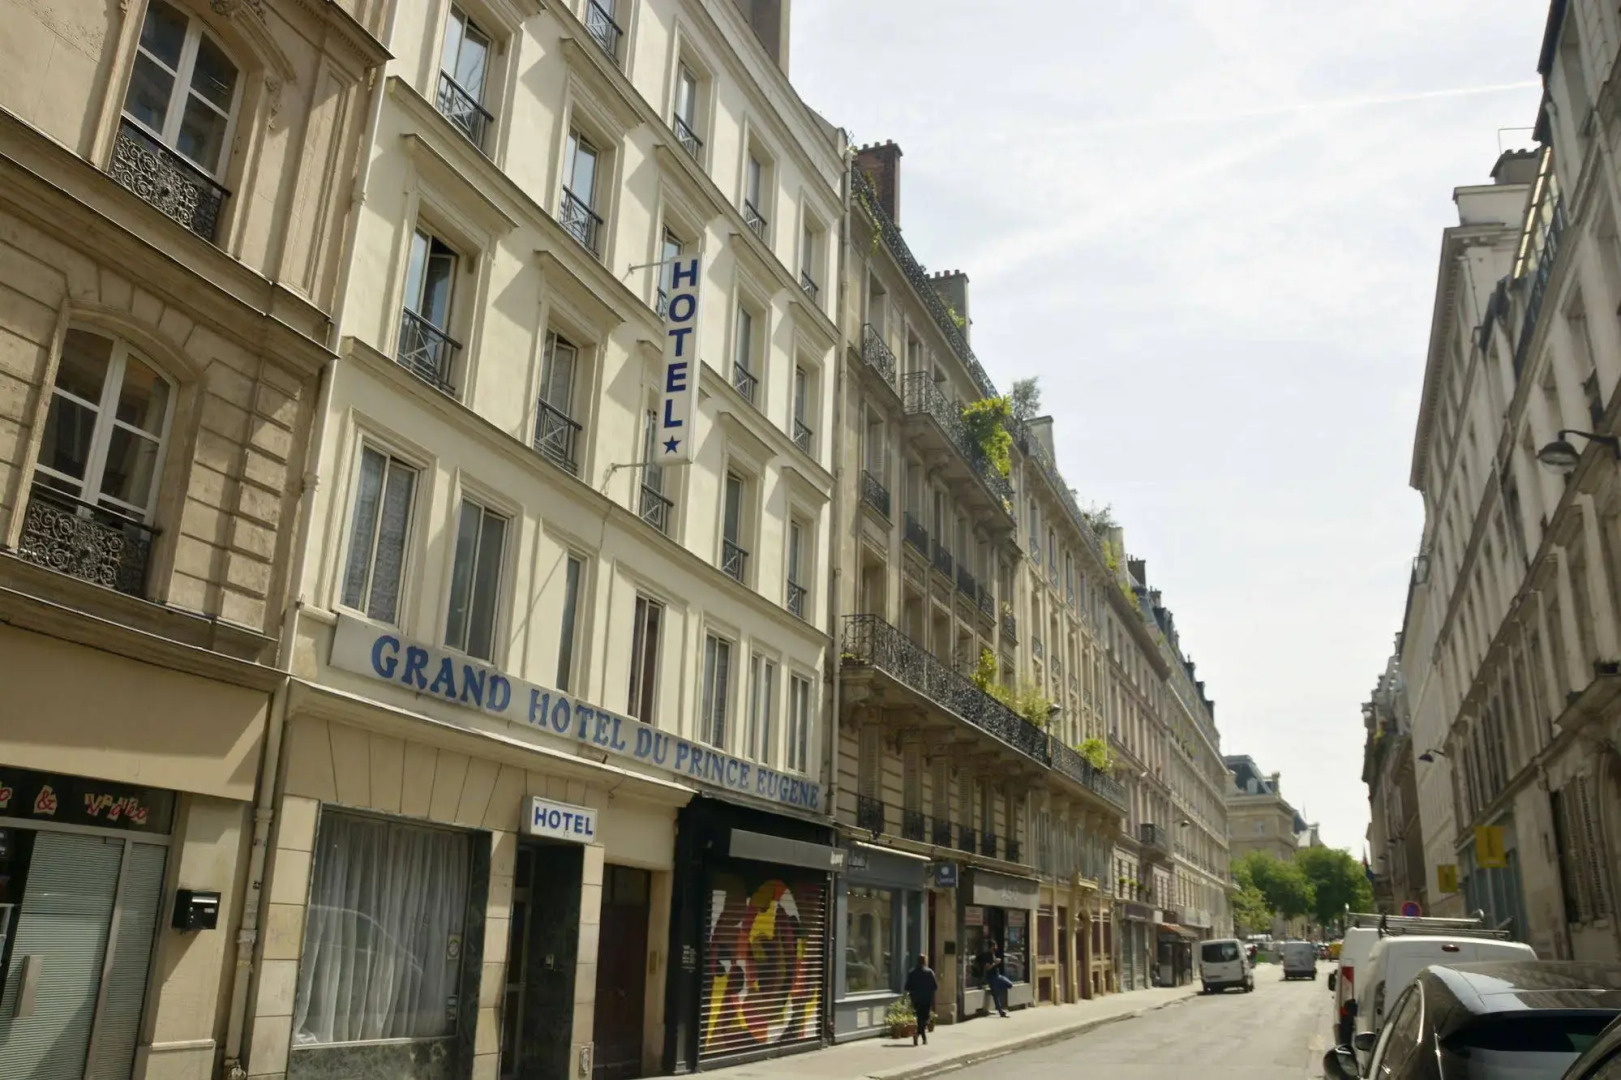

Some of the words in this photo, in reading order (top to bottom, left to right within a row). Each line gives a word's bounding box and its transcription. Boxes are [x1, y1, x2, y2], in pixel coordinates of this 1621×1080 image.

[664, 259, 698, 428] HOTEL
[371, 634, 512, 712] GRAND
[528, 688, 626, 751] HOTEL
[634, 727, 669, 764] DU
[674, 741, 750, 789] PRINCE
[756, 767, 820, 809] EUGENE
[37, 789, 56, 811] &
[533, 806, 593, 836] HOTEL
